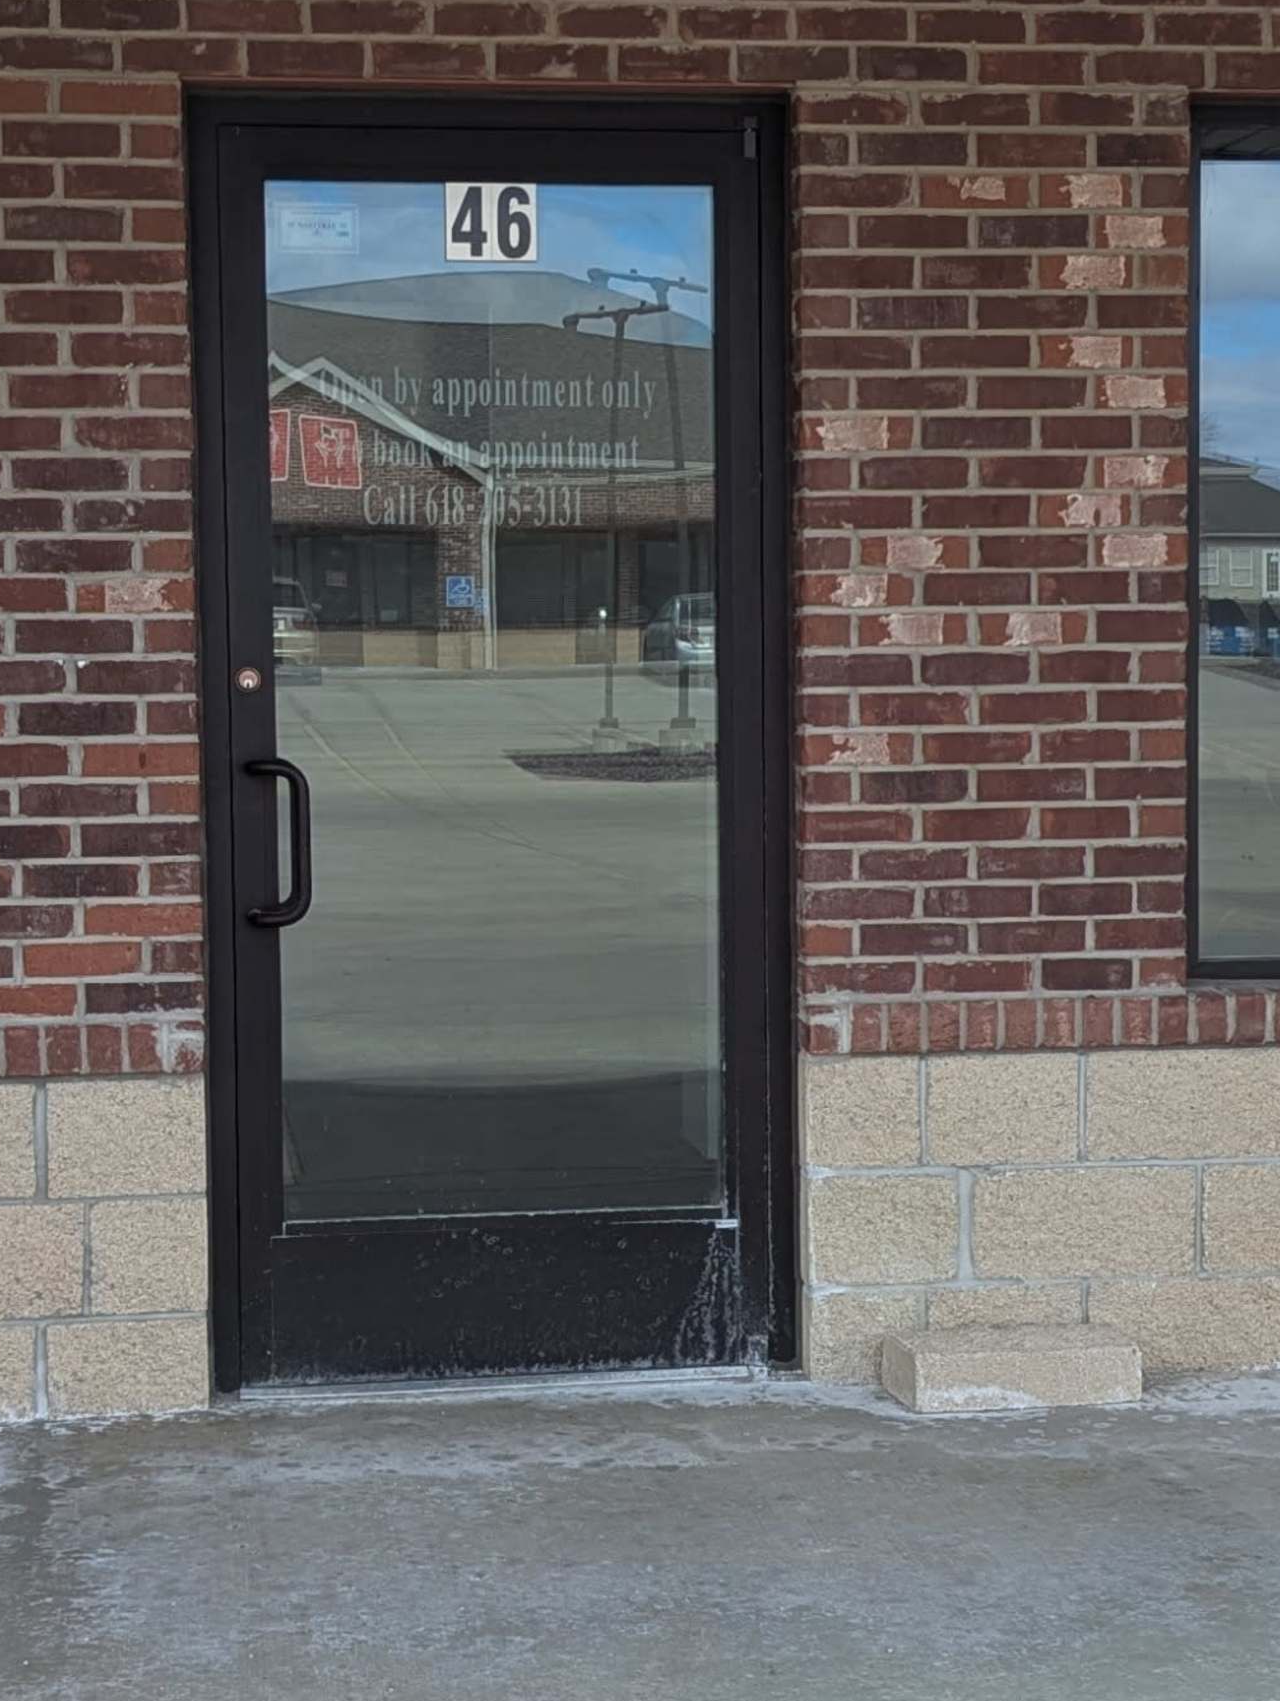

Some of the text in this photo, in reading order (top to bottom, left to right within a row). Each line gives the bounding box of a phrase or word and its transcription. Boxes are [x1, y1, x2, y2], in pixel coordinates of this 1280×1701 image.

[451, 186, 532, 258] 46
[319, 366, 657, 419] Open by appointment only
[373, 428, 434, 468] book
[442, 440, 470, 468] an
[479, 431, 640, 480] appointment
[363, 484, 417, 526] Call
